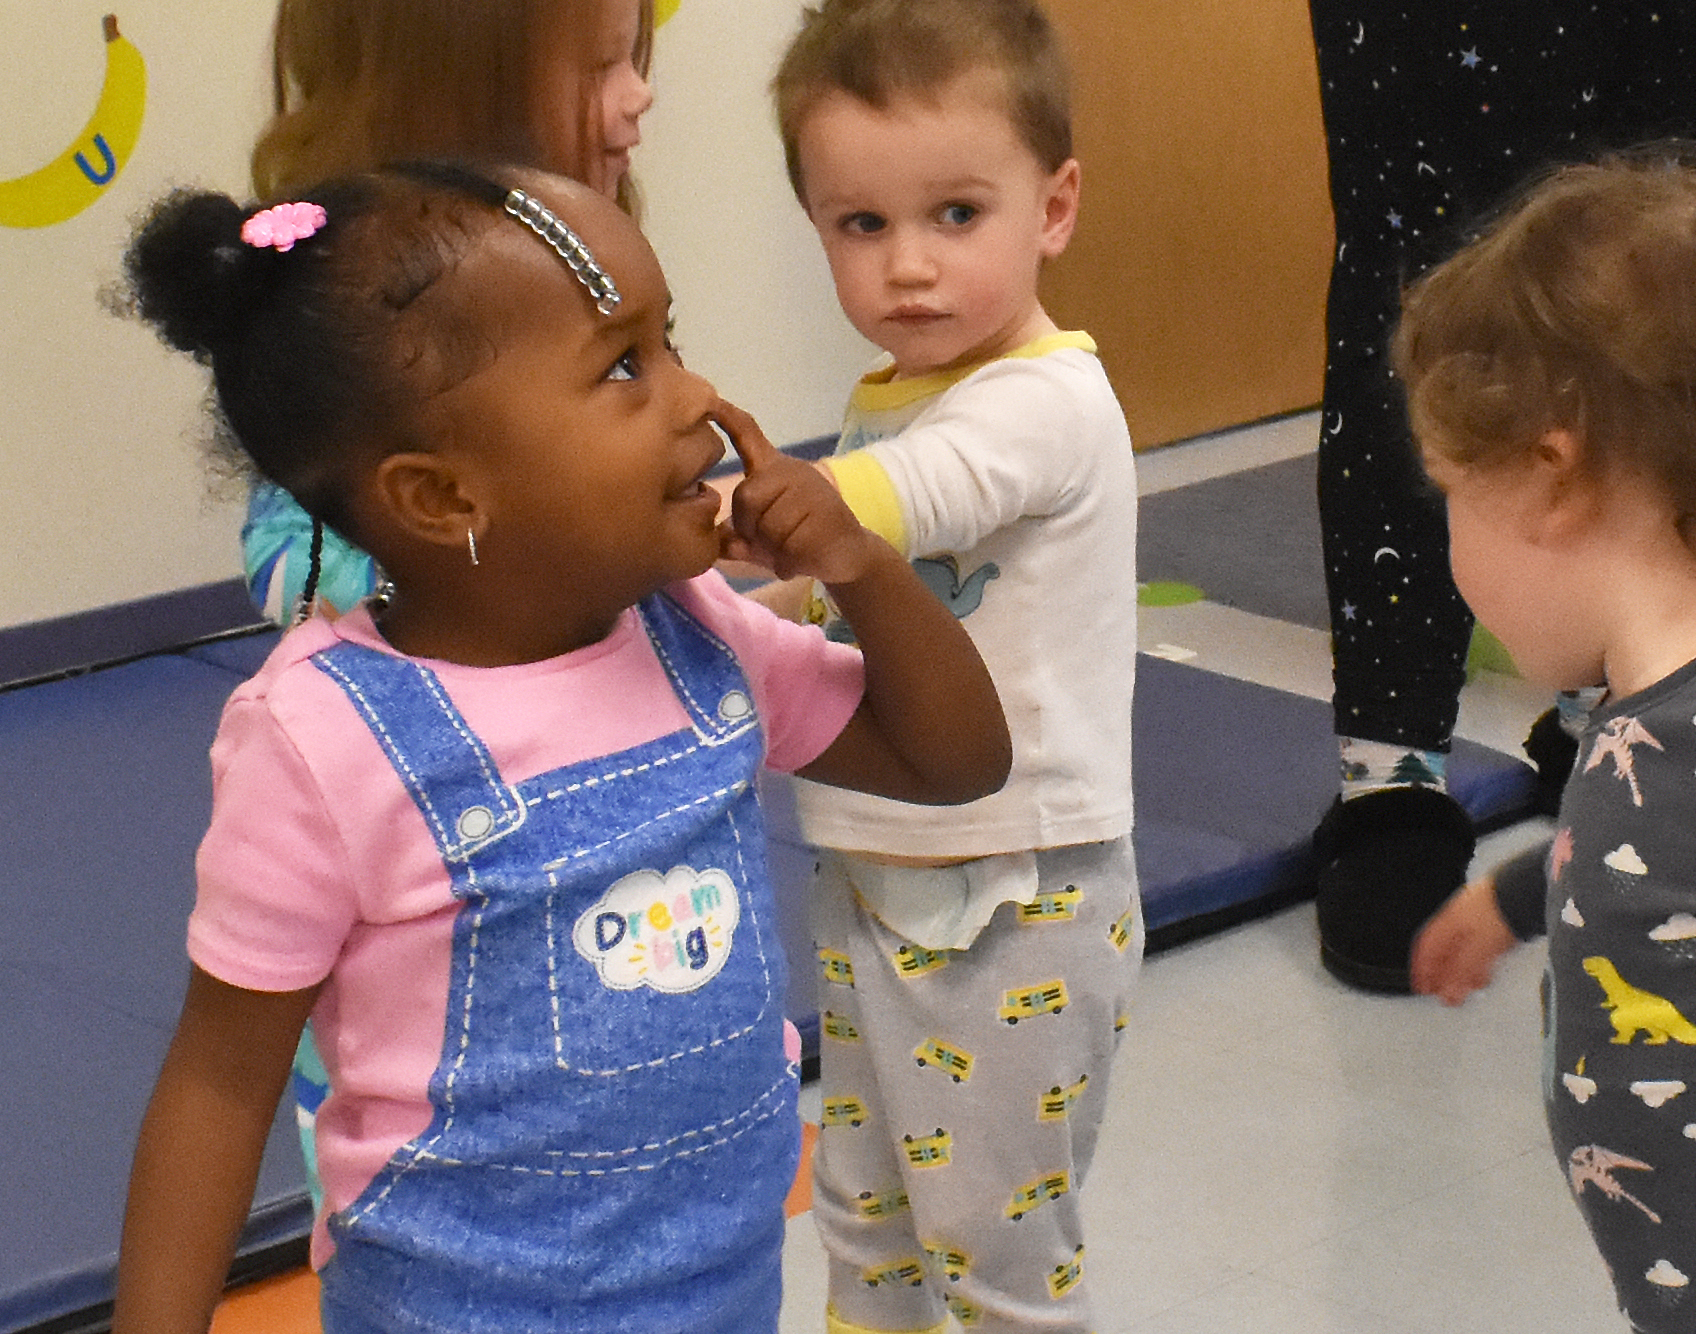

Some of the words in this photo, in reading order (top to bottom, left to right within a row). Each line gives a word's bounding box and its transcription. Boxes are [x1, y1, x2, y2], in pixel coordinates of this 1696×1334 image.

[75, 135, 115, 185] U
[594, 885, 721, 953] Dream
[652, 926, 709, 971] big
